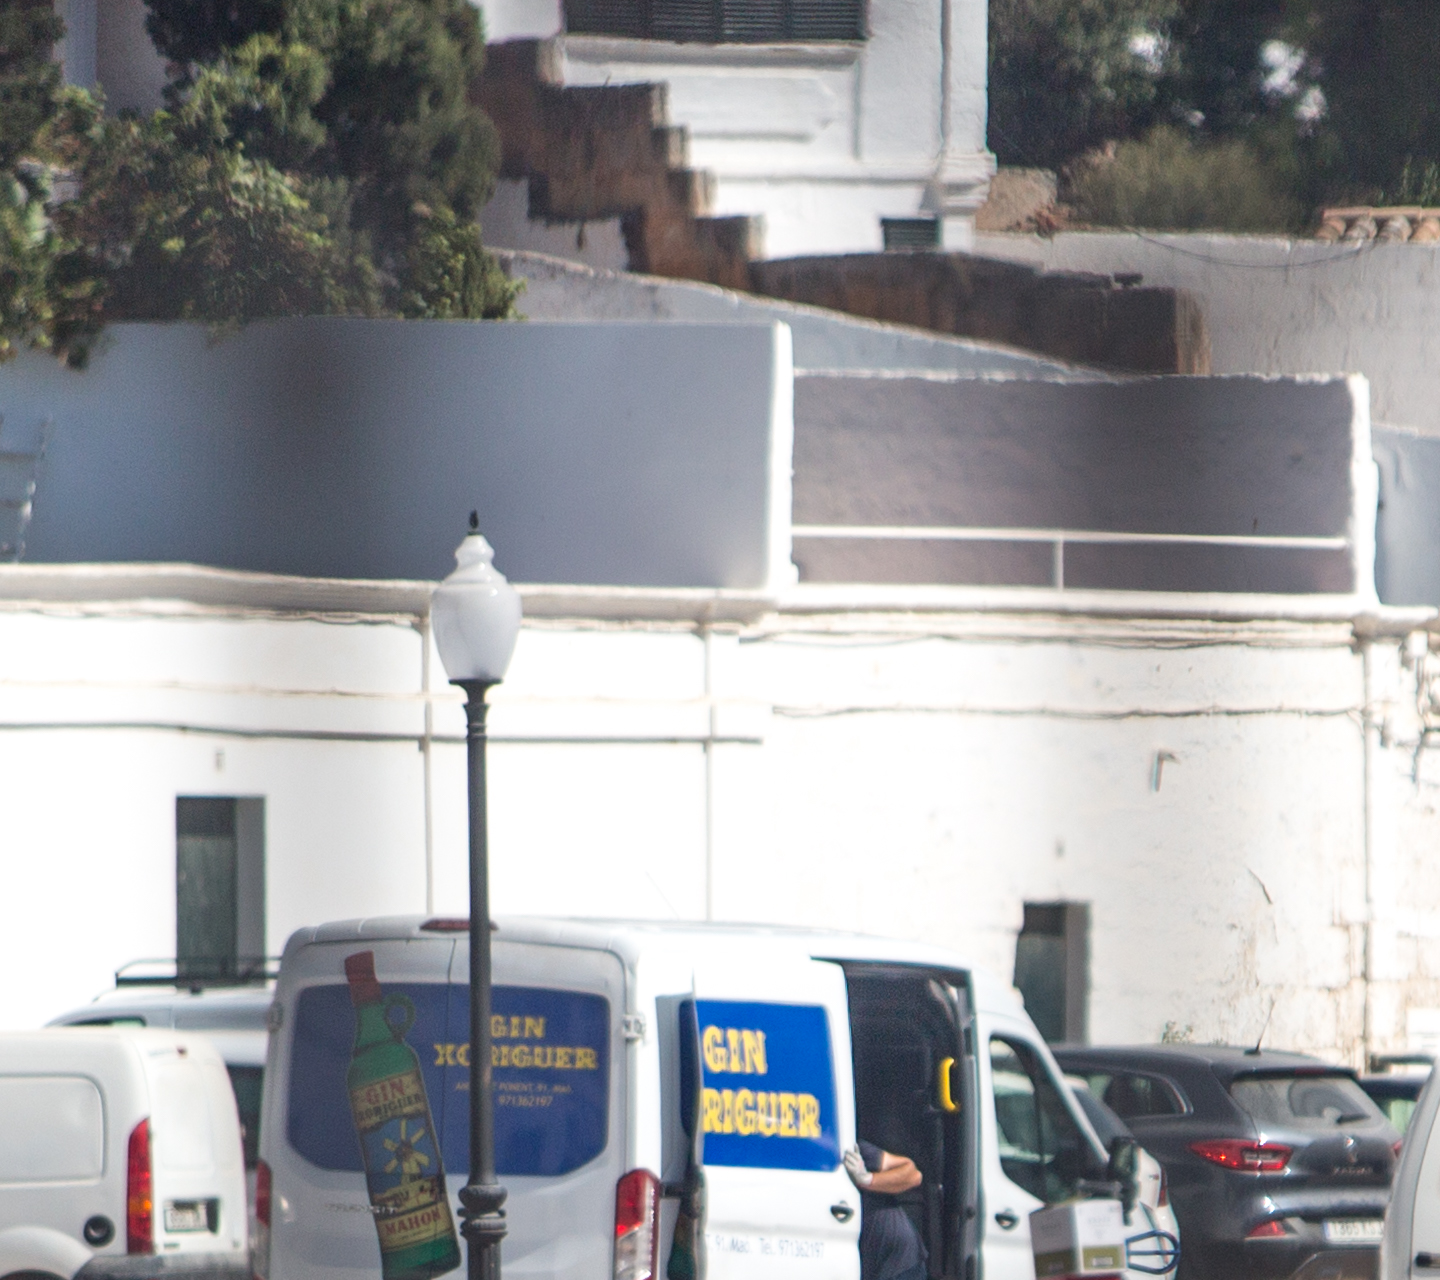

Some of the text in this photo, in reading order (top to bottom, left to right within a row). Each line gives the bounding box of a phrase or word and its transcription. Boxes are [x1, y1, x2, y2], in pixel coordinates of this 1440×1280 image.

[490, 1014, 546, 1038] GIN
[702, 1025, 768, 1075] GIN
[366, 1078, 406, 1105] GIN
